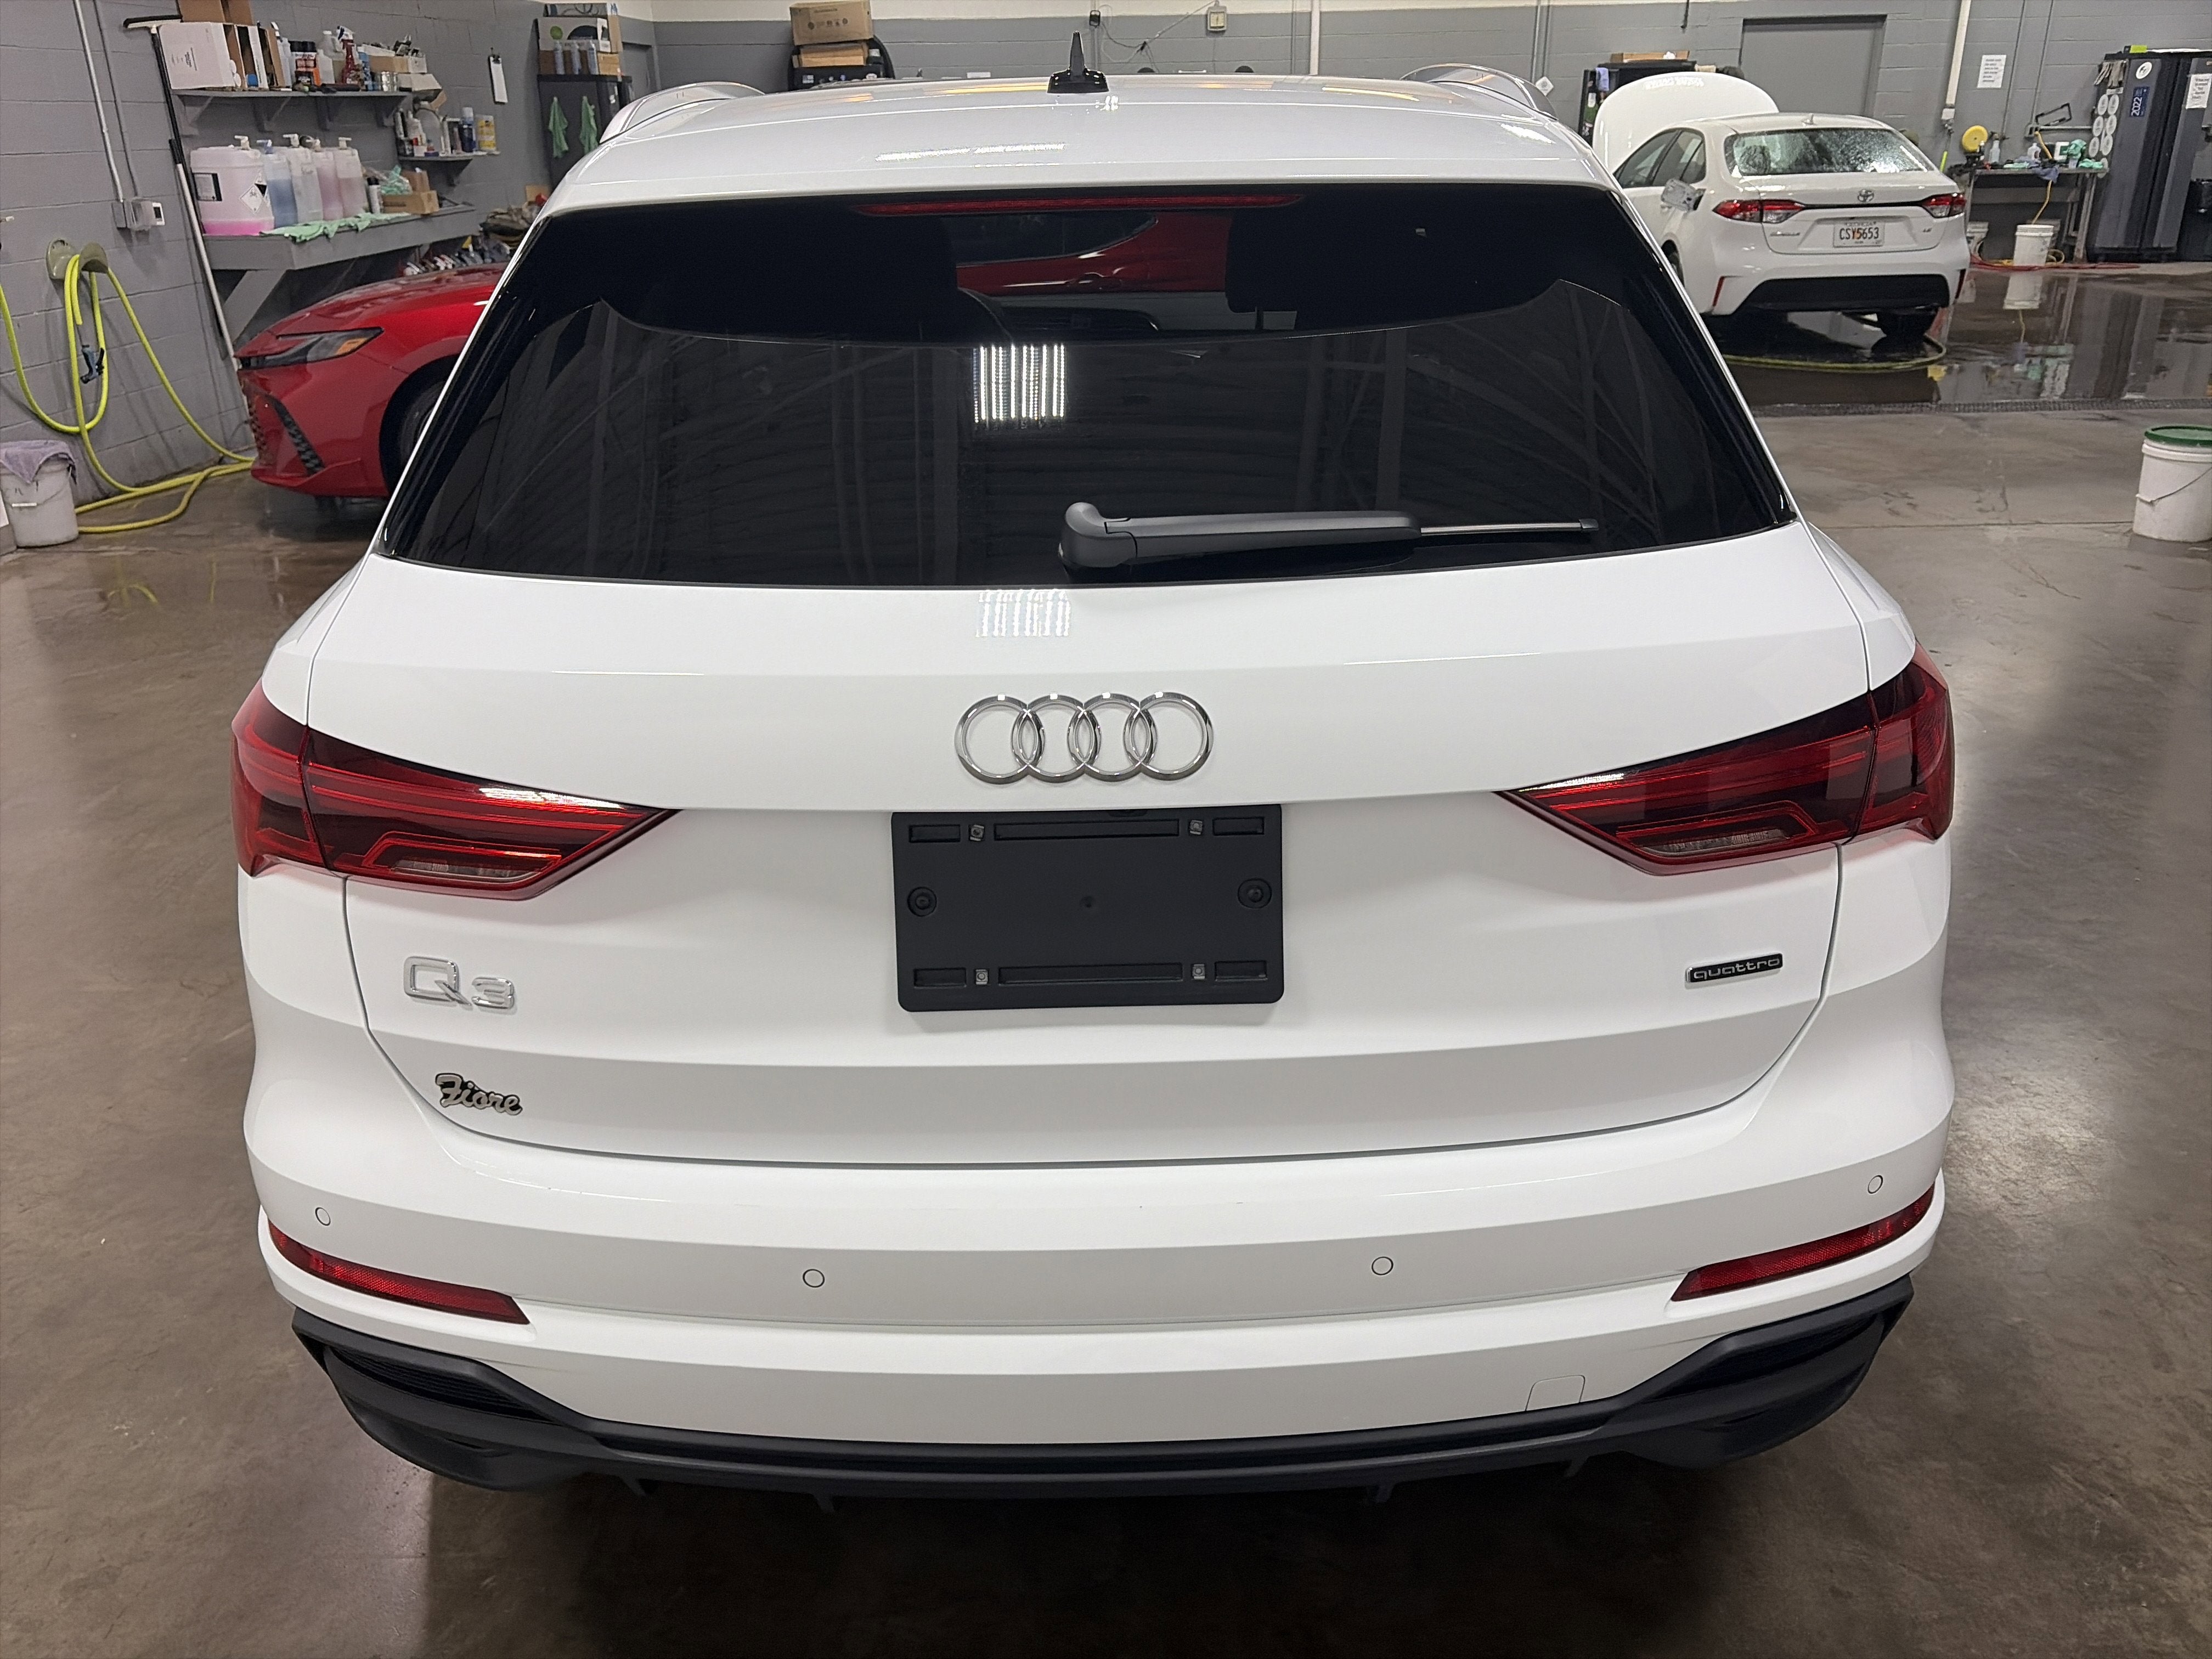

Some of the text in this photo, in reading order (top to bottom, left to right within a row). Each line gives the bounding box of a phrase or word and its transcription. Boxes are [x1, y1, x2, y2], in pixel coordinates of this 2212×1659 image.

[2131, 97, 2143, 116] 2022
[1839, 227, 1879, 240] CSY5653
[1694, 958, 1780, 980] quattro
[403, 956, 515, 1009] Q3
[435, 1073, 523, 1116] Fiore
